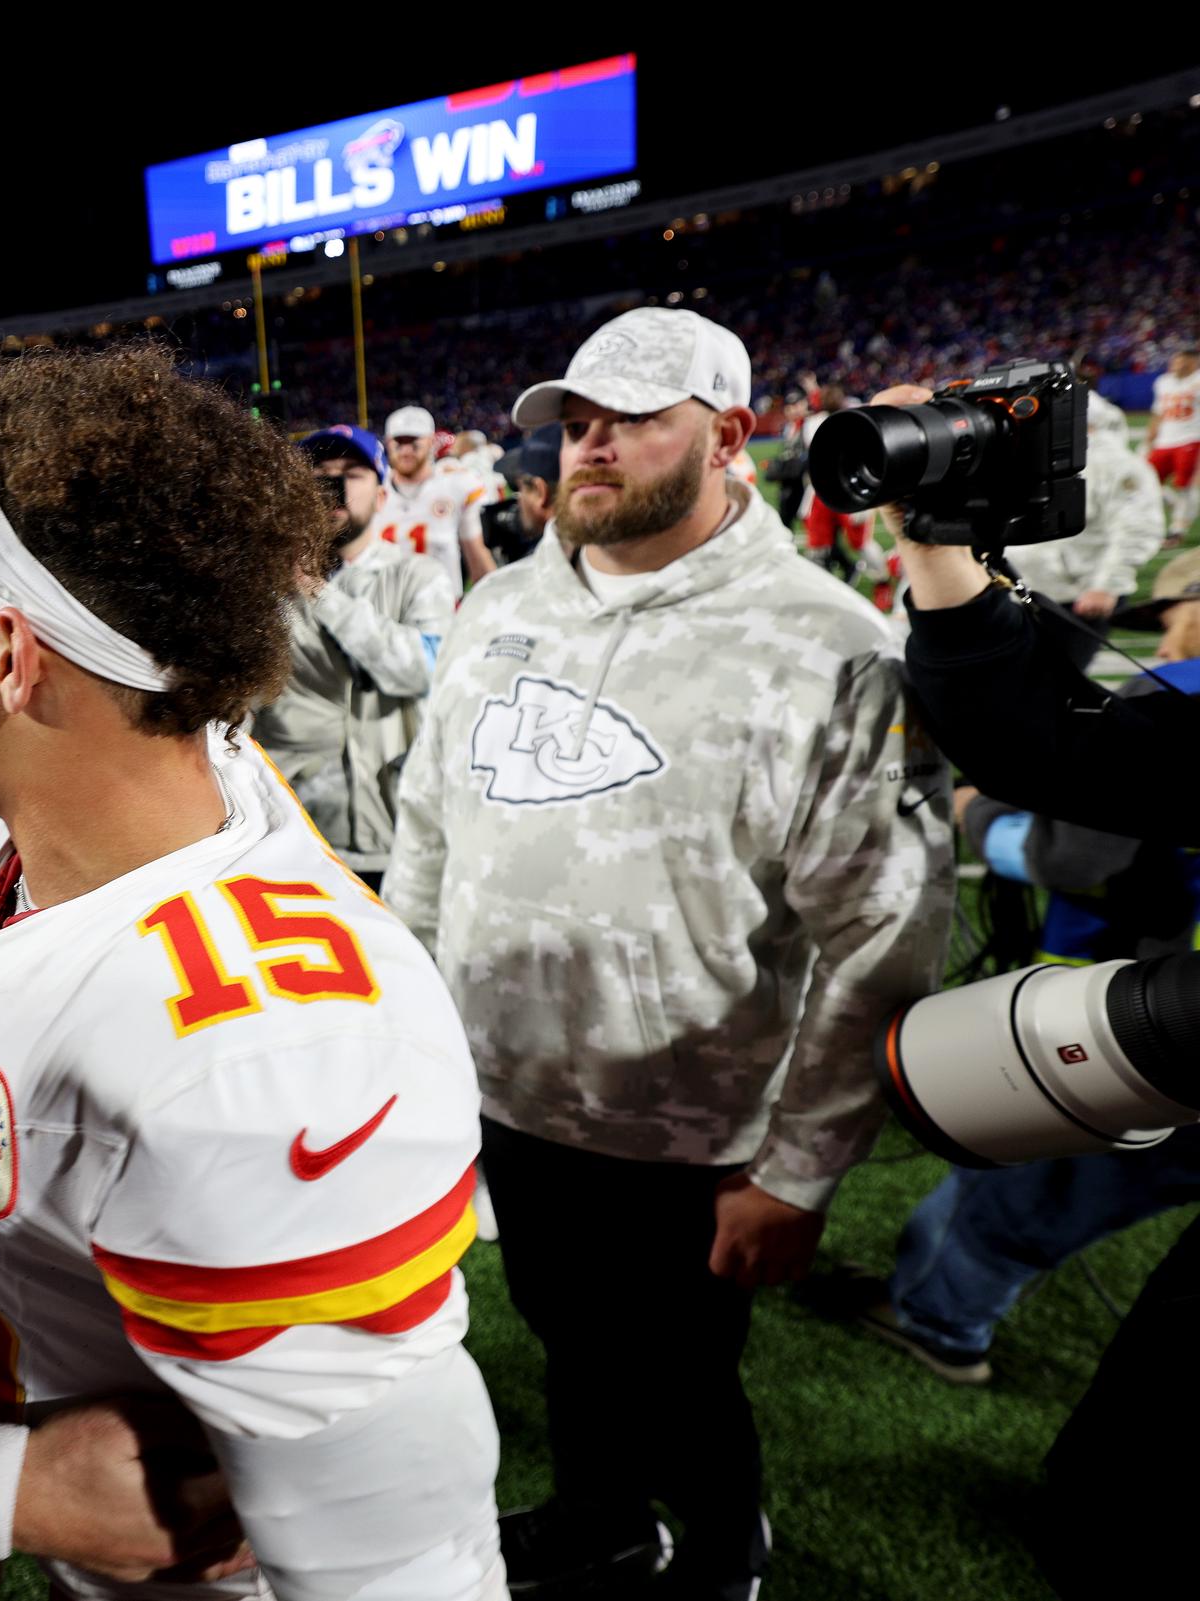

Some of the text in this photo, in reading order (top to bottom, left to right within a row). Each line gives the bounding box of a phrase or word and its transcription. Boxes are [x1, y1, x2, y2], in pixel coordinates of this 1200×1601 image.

[226, 157, 395, 235] BILLS
[409, 112, 538, 195] WIN
[137, 873, 382, 1038] 15
